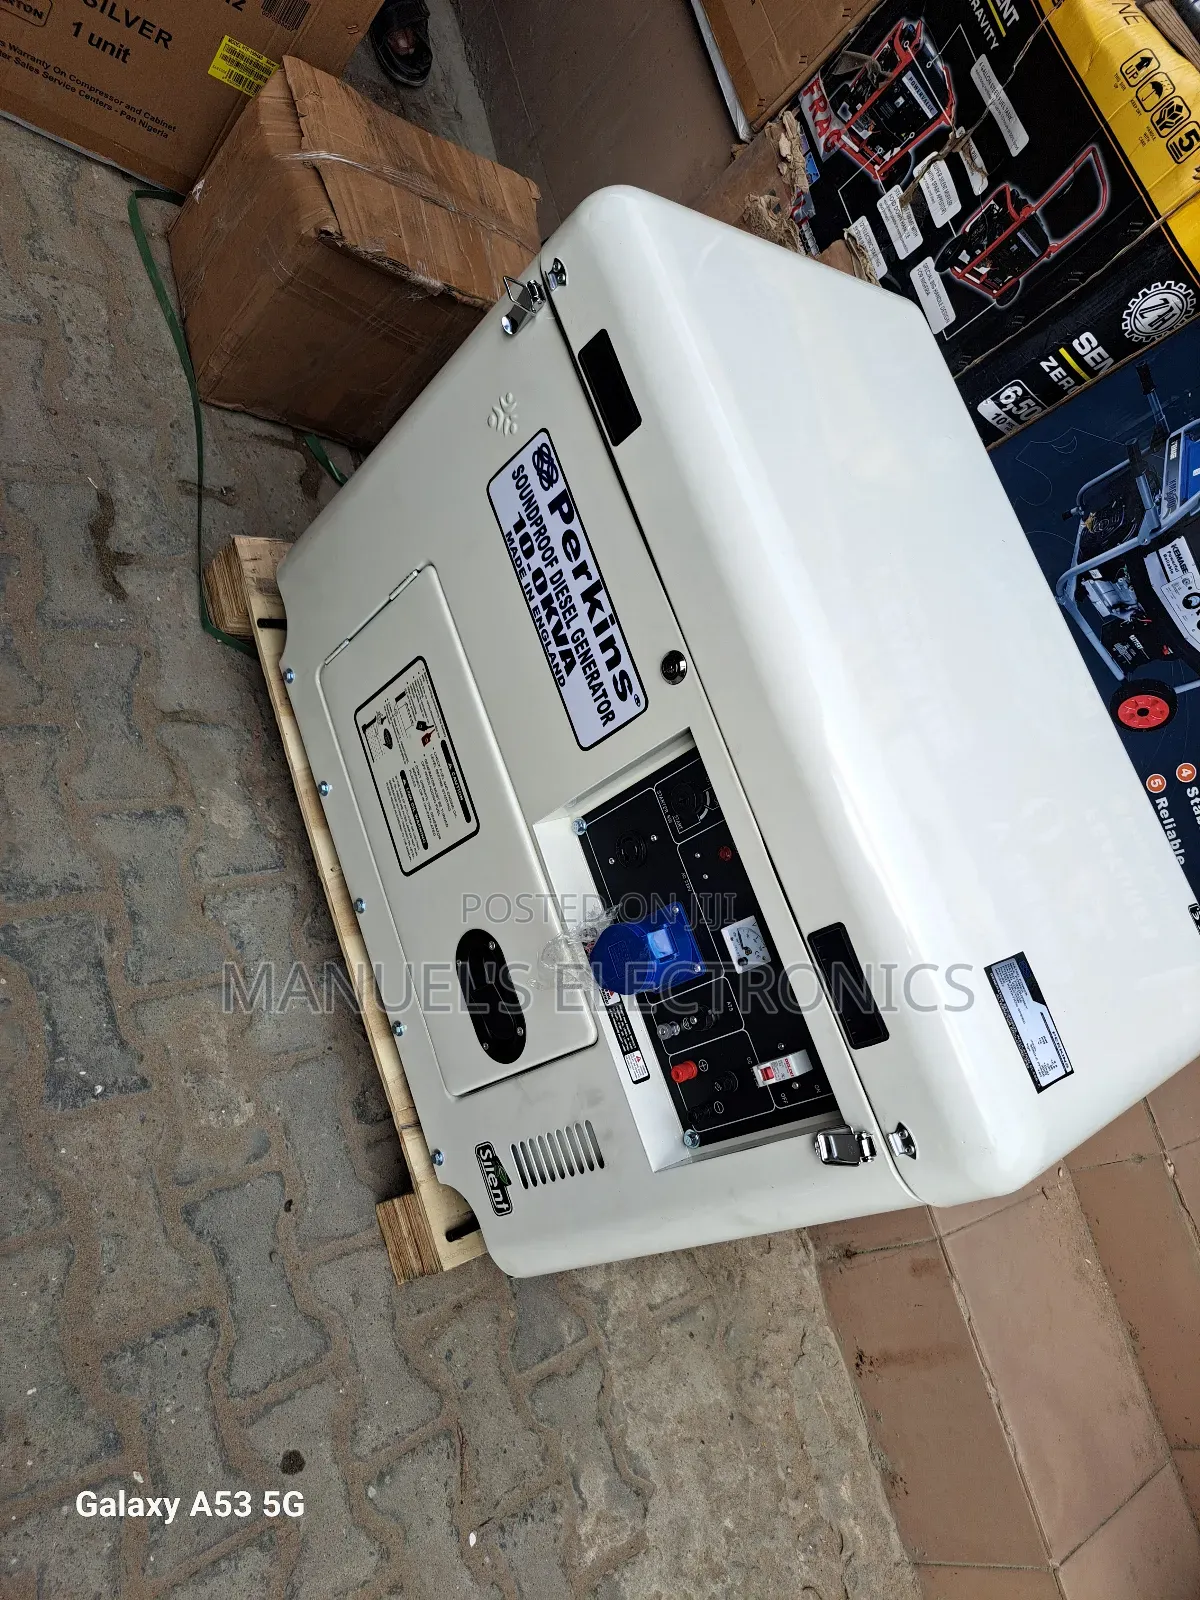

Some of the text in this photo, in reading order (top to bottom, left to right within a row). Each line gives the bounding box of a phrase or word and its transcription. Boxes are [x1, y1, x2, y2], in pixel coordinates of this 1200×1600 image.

[67, 19, 131, 64] 1 unit
[82, 0, 174, 50] SILVER
[968, 0, 999, 50] RAVITY
[6, 43, 51, 70] Warranty
[52, 65, 67, 77] On
[67, 73, 124, 107] Compressor
[124, 102, 142, 115] and
[142, 111, 177, 132] Cabinet
[1123, 64, 1139, 81] UP
[12, 56, 41, 75] Sales
[40, 71, 77, 93] Service
[77, 89, 114, 111] Centers
[119, 110, 137, 123] Pan
[137, 119, 169, 140] Nigeria
[802, 76, 844, 153] FRAG
[1129, 98, 1137, 109] KEEP
[1175, 127, 1200, 154] 5
[1162, 553, 1174, 574] Reliable
[504, 530, 566, 688] MADE IN ENGLAND
[511, 511, 579, 677] 10.0KVA
[511, 463, 617, 727] SOUNDPROOF DIESEL GENERATOR
[450, 771, 463, 800] CAUTION
[413, 813, 426, 843] WARNING
[1154, 795, 1185, 864] Reliable
[778, 1091, 789, 1105] OFF
[479, 1147, 509, 1210] Silent
